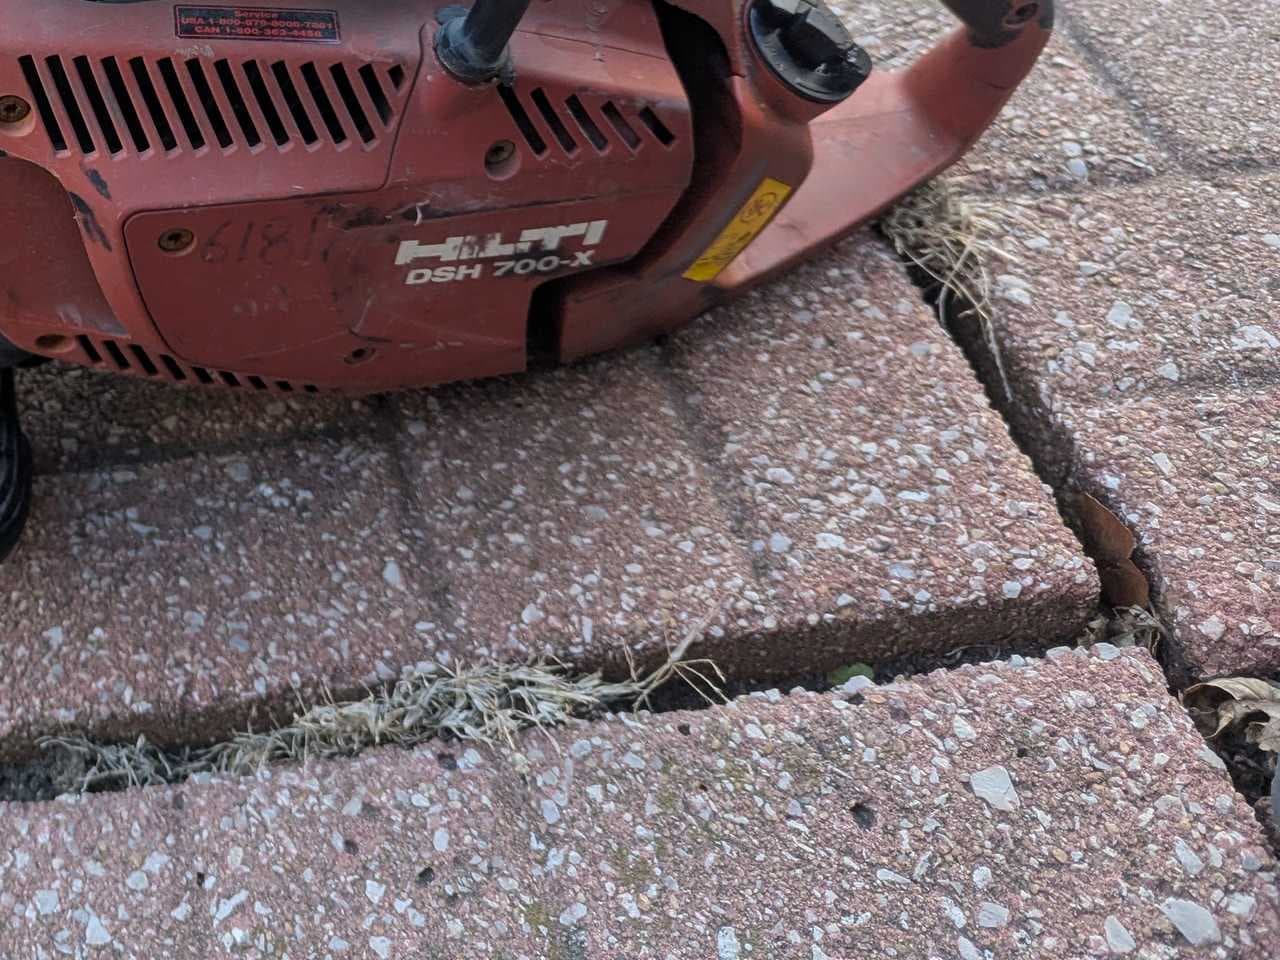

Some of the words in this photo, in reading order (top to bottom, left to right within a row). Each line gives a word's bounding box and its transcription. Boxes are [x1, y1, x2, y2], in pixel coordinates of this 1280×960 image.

[181, 16, 206, 25] USA
[194, 26, 221, 35] CAN
[395, 220, 608, 265] HILTI
[405, 264, 482, 285] DSH
[493, 250, 595, 277] 700-X
